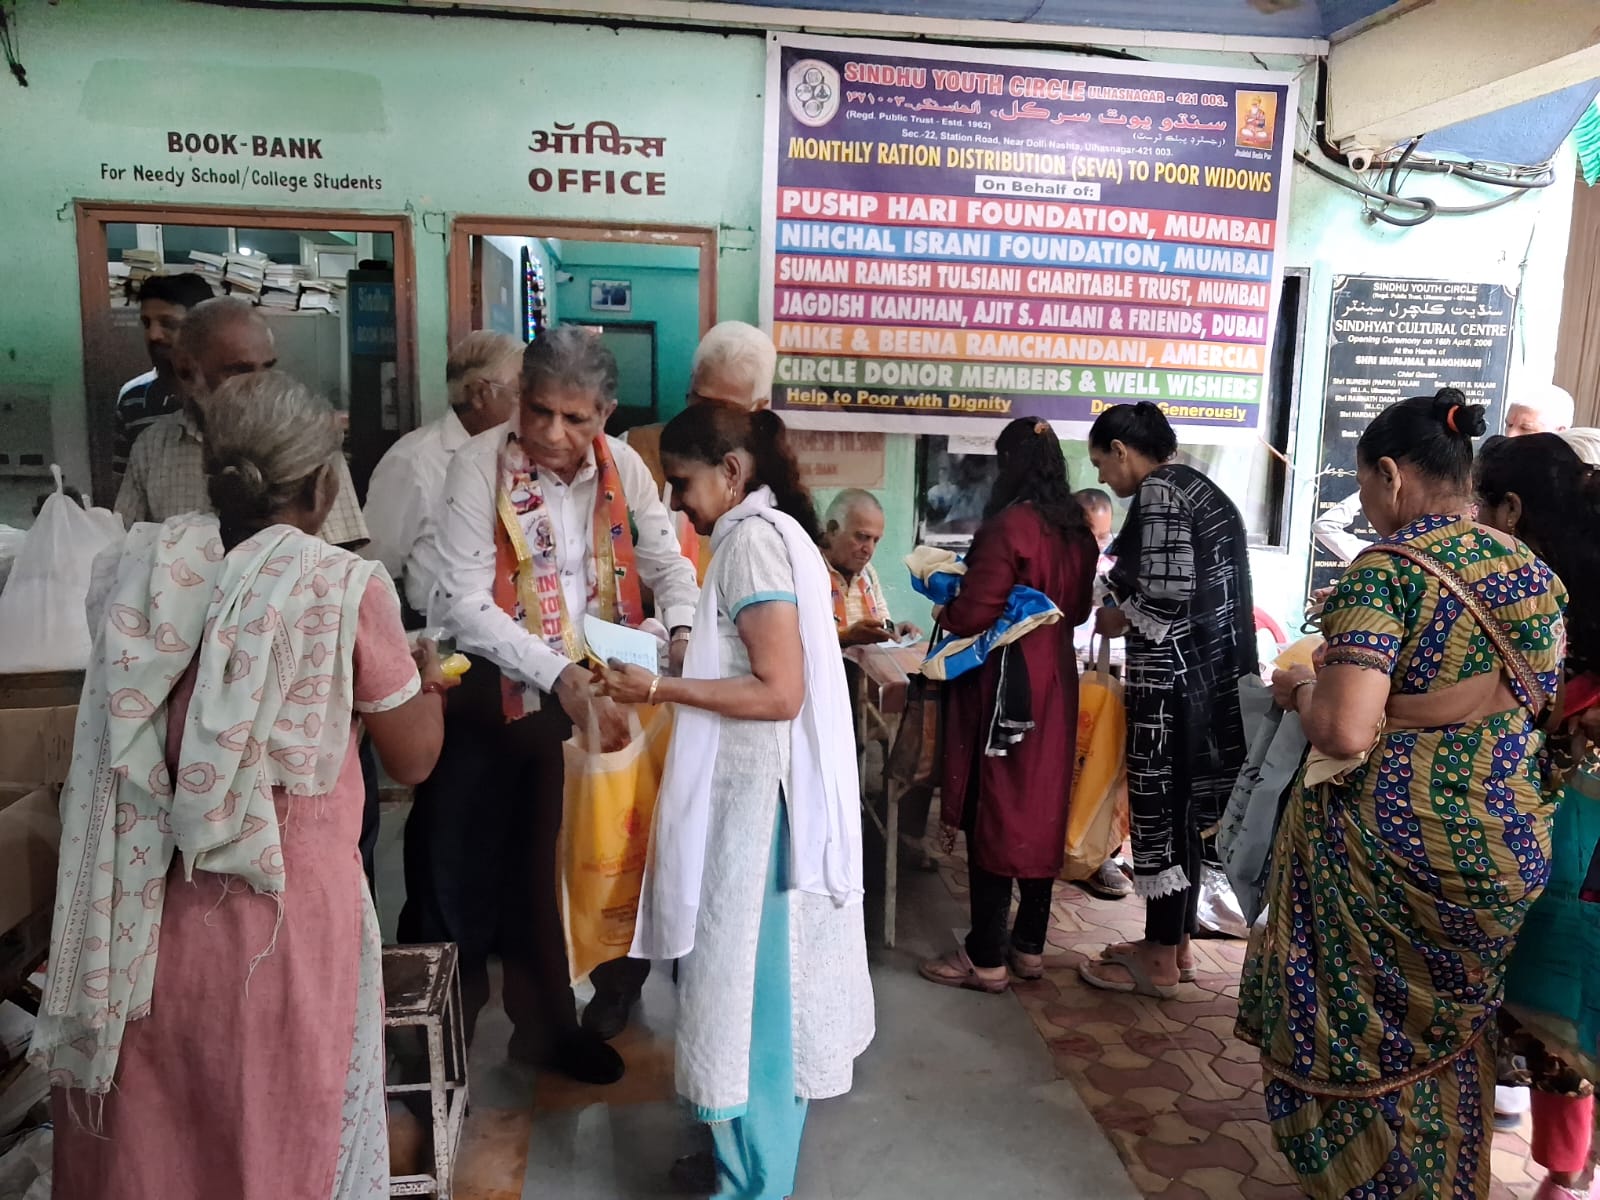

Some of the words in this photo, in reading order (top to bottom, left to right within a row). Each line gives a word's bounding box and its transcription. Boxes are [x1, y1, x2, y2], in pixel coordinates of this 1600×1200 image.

[844, 62, 927, 88] SINDHU
[932, 69, 1004, 95] YOUTH
[1009, 74, 1086, 101] CIRCLE
[1088, 85, 1165, 103] ULHASNAGAR
[1176, 92, 1197, 105] 421
[1202, 93, 1228, 107] 003.
[846, 110, 877, 121] (Regd.
[879, 112, 908, 122] Public
[910, 115, 934, 125] Trust
[942, 117, 965, 127] Estd.
[968, 120, 992, 130] 1962)
[167, 131, 323, 159] BOOK-BANK
[528, 120, 667, 158] ऑफिस
[940, 131, 973, 143] Station
[975, 133, 1001, 145] Road,
[1003, 136, 1025, 147] Near
[100, 163, 127, 180] For
[133, 164, 185, 187] Needy
[313, 173, 382, 190] Students
[788, 137, 874, 164] MONTHLY
[877, 144, 941, 167] RATION
[947, 146, 1066, 175] DISTRIBUTION
[1071, 157, 1123, 185] (SEVA)
[1128, 160, 1149, 182] TO
[1154, 162, 1200, 186] POOR
[1204, 166, 1272, 193] WIDOWS
[528, 167, 666, 196] OFFICE
[982, 179, 1005, 192] On
[1011, 180, 1066, 196] Behalf
[1072, 185, 1094, 197] of:
[782, 190, 878, 218] PUSHP
[887, 196, 958, 222] HARI
[967, 201, 1156, 240] FOUNDATION,
[1164, 214, 1271, 245] MUMBAI
[782, 224, 896, 253] NIHCHAL
[904, 230, 992, 257] ISRANI
[1000, 235, 1167, 272] FOUNDATION,
[1174, 247, 1269, 276] MUMBAI
[779, 256, 849, 284] SUMAN
[855, 261, 932, 288] RAMESH
[937, 265, 1021, 292] TULSIANI
[1026, 270, 1133, 298] CHARITABLE
[1139, 277, 1192, 306] TRUST,
[1197, 281, 1266, 307] MUMBAI
[1372, 282, 1408, 292] SINDHU
[1411, 284, 1442, 293] YOUTH
[1444, 285, 1479, 294] CIRCLE
[779, 291, 864, 318] JAGDISH
[870, 295, 968, 328] KANJHAN,
[972, 301, 1014, 325] AJIT
[1018, 302, 1034, 326] S.
[1039, 304, 1103, 329] AILANI
[1108, 307, 1123, 331] &
[1129, 308, 1206, 339] FRIENDS,
[1211, 314, 1264, 338] DUBAI
[1335, 319, 1395, 333] SINDHYAT
[1397, 322, 1458, 335] CULTURAL
[1460, 323, 1507, 337] CENTRE
[779, 325, 843, 350] MIKE
[851, 328, 870, 352] &
[879, 329, 957, 356] BEENA
[965, 333, 1153, 368] RAMCHANDANI,
[1160, 342, 1258, 369] AMERCIA
[1347, 334, 1380, 345] Opening
[1381, 336, 1421, 346] Ceremony
[1393, 347, 1402, 355] At
[1355, 355, 1377, 365] SHRI
[778, 357, 857, 383] CIRCLE
[864, 361, 953, 387] DONOR
[959, 366, 1072, 392] MEMBERS
[1078, 370, 1097, 393] &
[1103, 371, 1161, 395] WELL
[1166, 373, 1258, 400] WISHERS
[786, 387, 829, 405] Help
[833, 389, 851, 404] to
[856, 390, 899, 406] Poor
[903, 392, 942, 408] with
[948, 394, 1012, 413] Dignity
[1160, 402, 1247, 422] Generously
